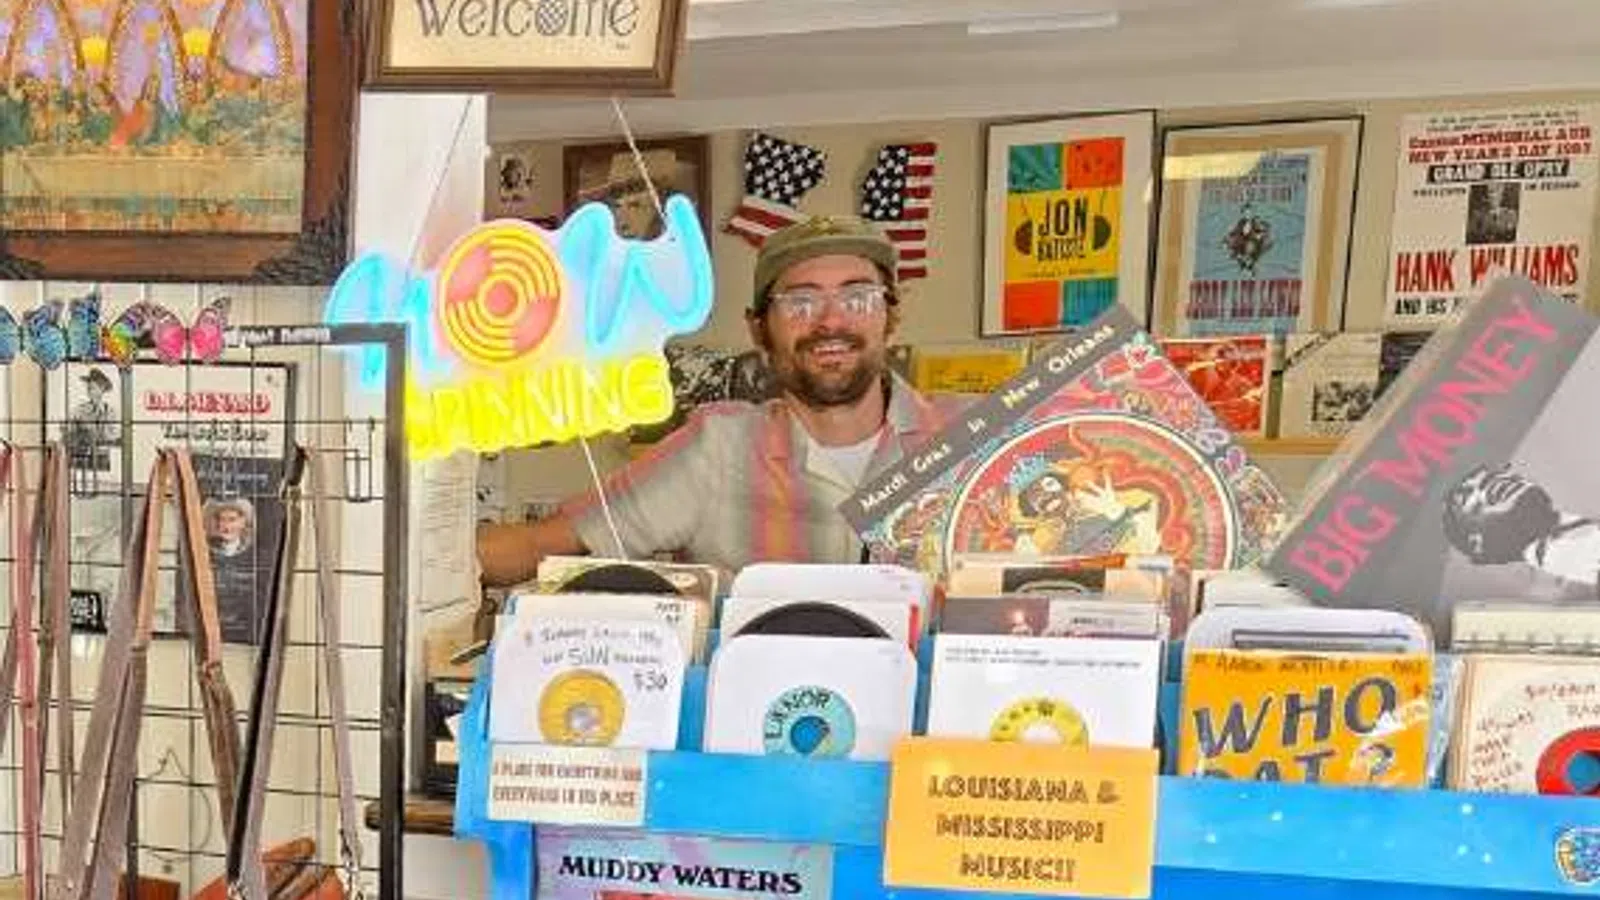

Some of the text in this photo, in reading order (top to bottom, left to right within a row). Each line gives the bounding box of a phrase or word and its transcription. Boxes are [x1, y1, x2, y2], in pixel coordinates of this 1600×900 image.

[1409, 150, 1448, 164] NEW
[1518, 144, 1552, 157] DAY
[1434, 160, 1566, 182] GRAND OLE OPRY
[1039, 196, 1088, 239] JON
[1395, 252, 1456, 292] HANK
[861, 469, 908, 512] Mardi
[913, 441, 952, 473] Gras
[1002, 376, 1041, 410] New
[1048, 323, 1116, 374] Orleans
[1288, 493, 1398, 595] BIG
[1350, 297, 1556, 503] MONEY
[1193, 677, 1396, 759] WHO
[928, 774, 1088, 804] LOUISIANA
[936, 814, 1105, 844] MISSISSIPPI
[558, 855, 803, 895] MUDDY WATERS
